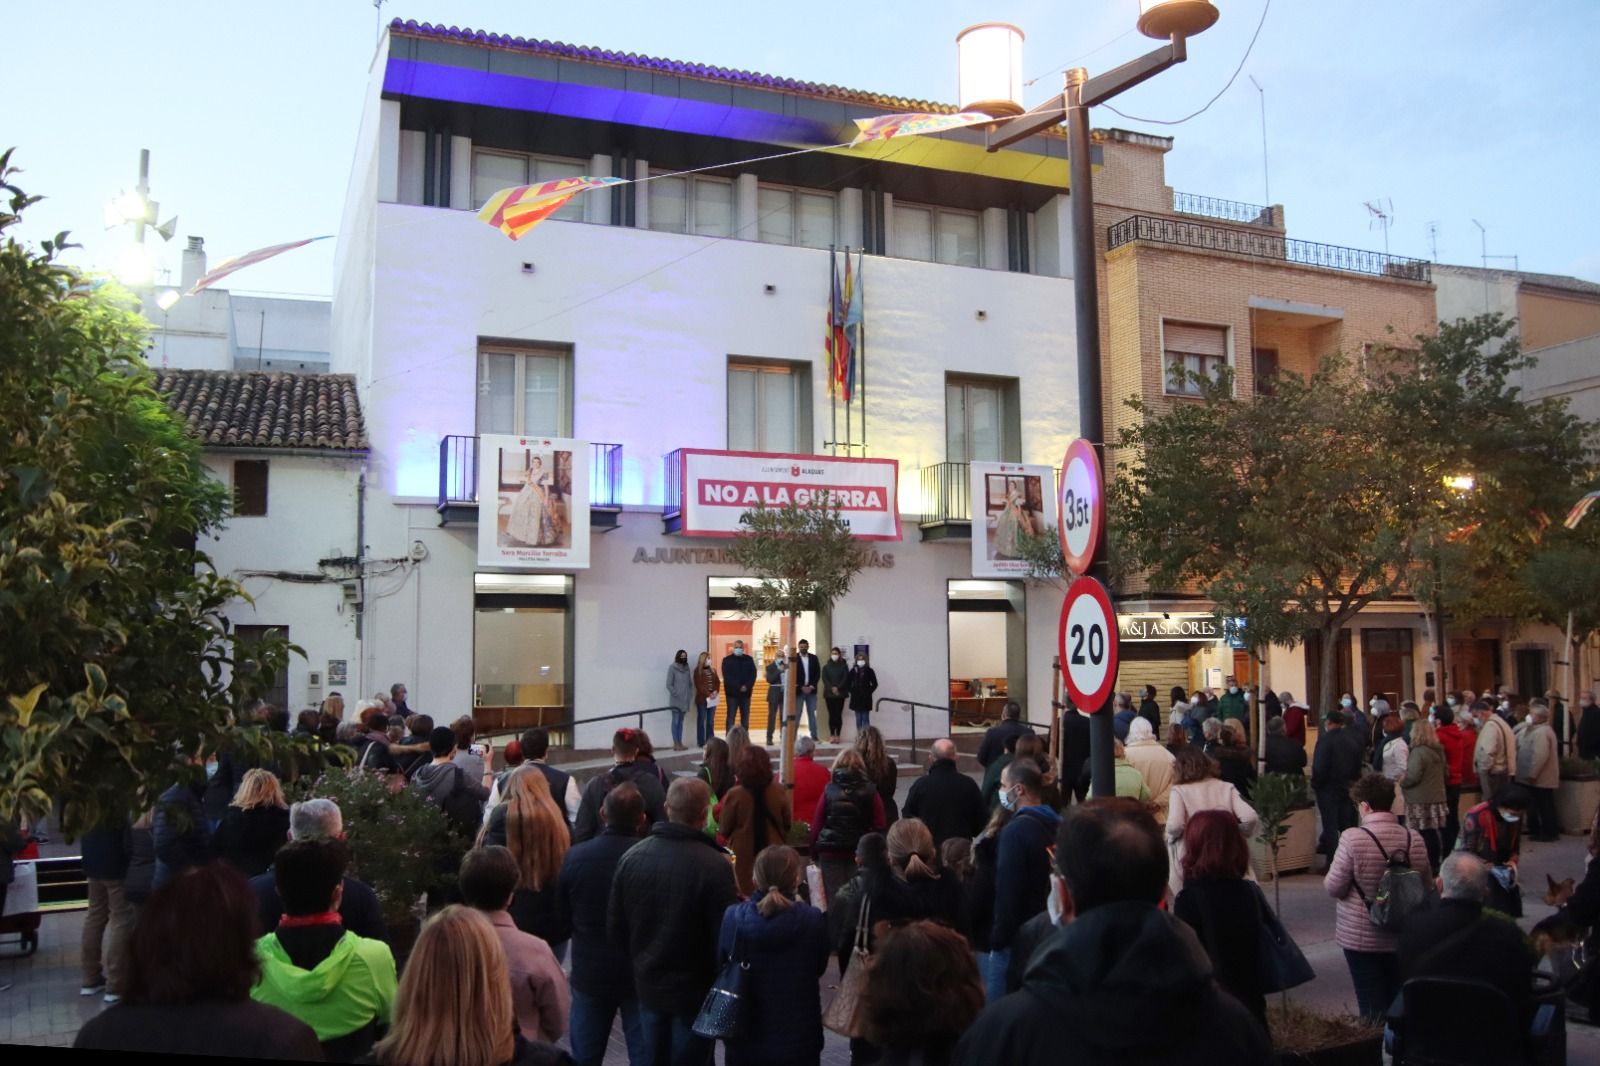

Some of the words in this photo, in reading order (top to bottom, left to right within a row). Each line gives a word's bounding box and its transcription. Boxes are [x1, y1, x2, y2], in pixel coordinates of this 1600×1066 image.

[704, 484, 739, 502] NO
[742, 486, 759, 504] A
[763, 487, 790, 505] LA
[794, 488, 882, 508] GUERRA
[1120, 621, 1147, 639] A&J
[1070, 623, 1104, 665] 20
